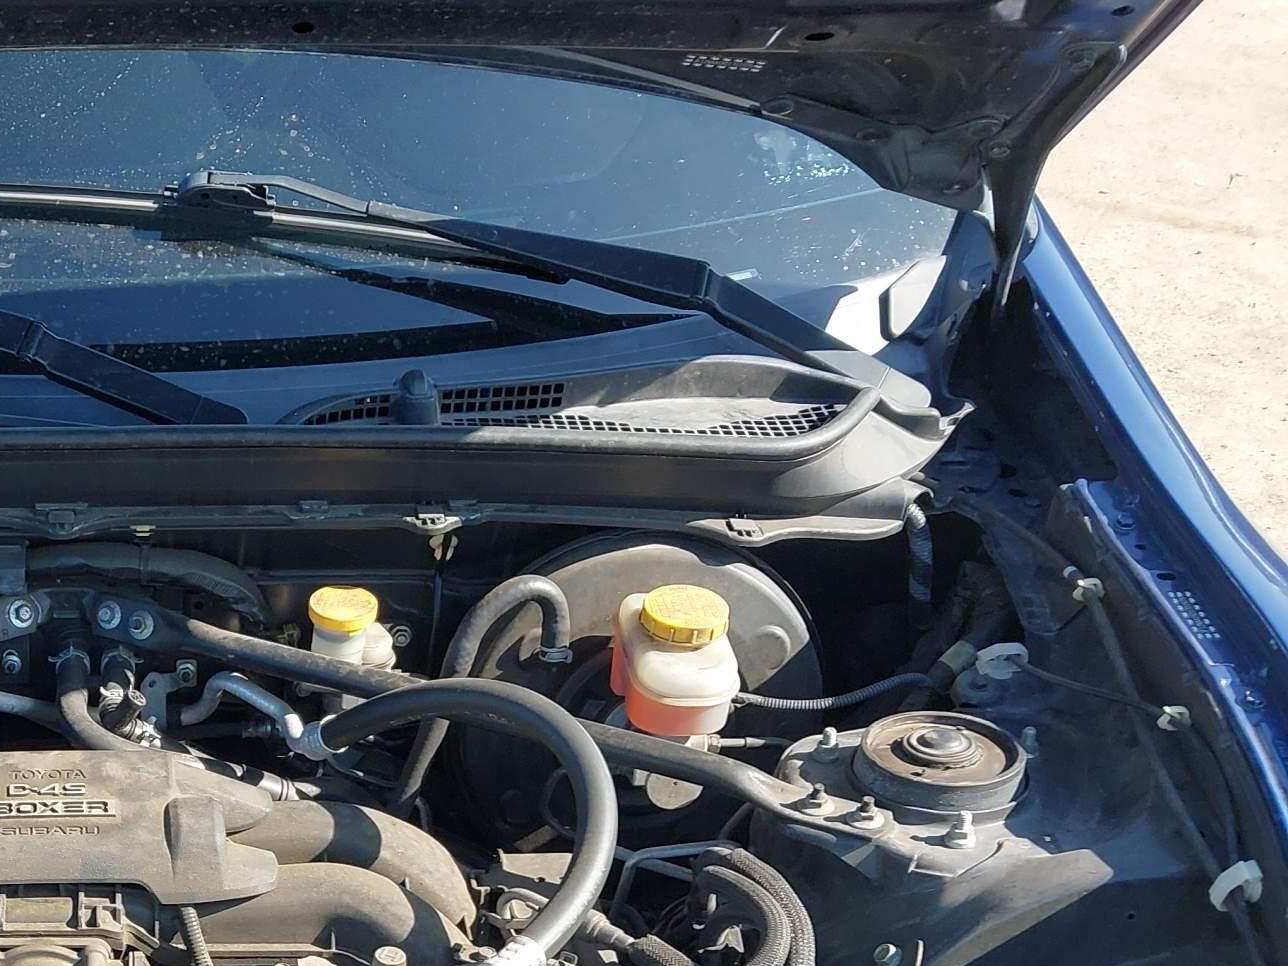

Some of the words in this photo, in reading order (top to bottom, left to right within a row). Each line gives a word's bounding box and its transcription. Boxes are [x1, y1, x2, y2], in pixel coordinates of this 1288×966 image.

[8, 768, 87, 780] TOYOTA
[6, 783, 87, 797] D-4S
[0, 824, 100, 836] SUBARU
